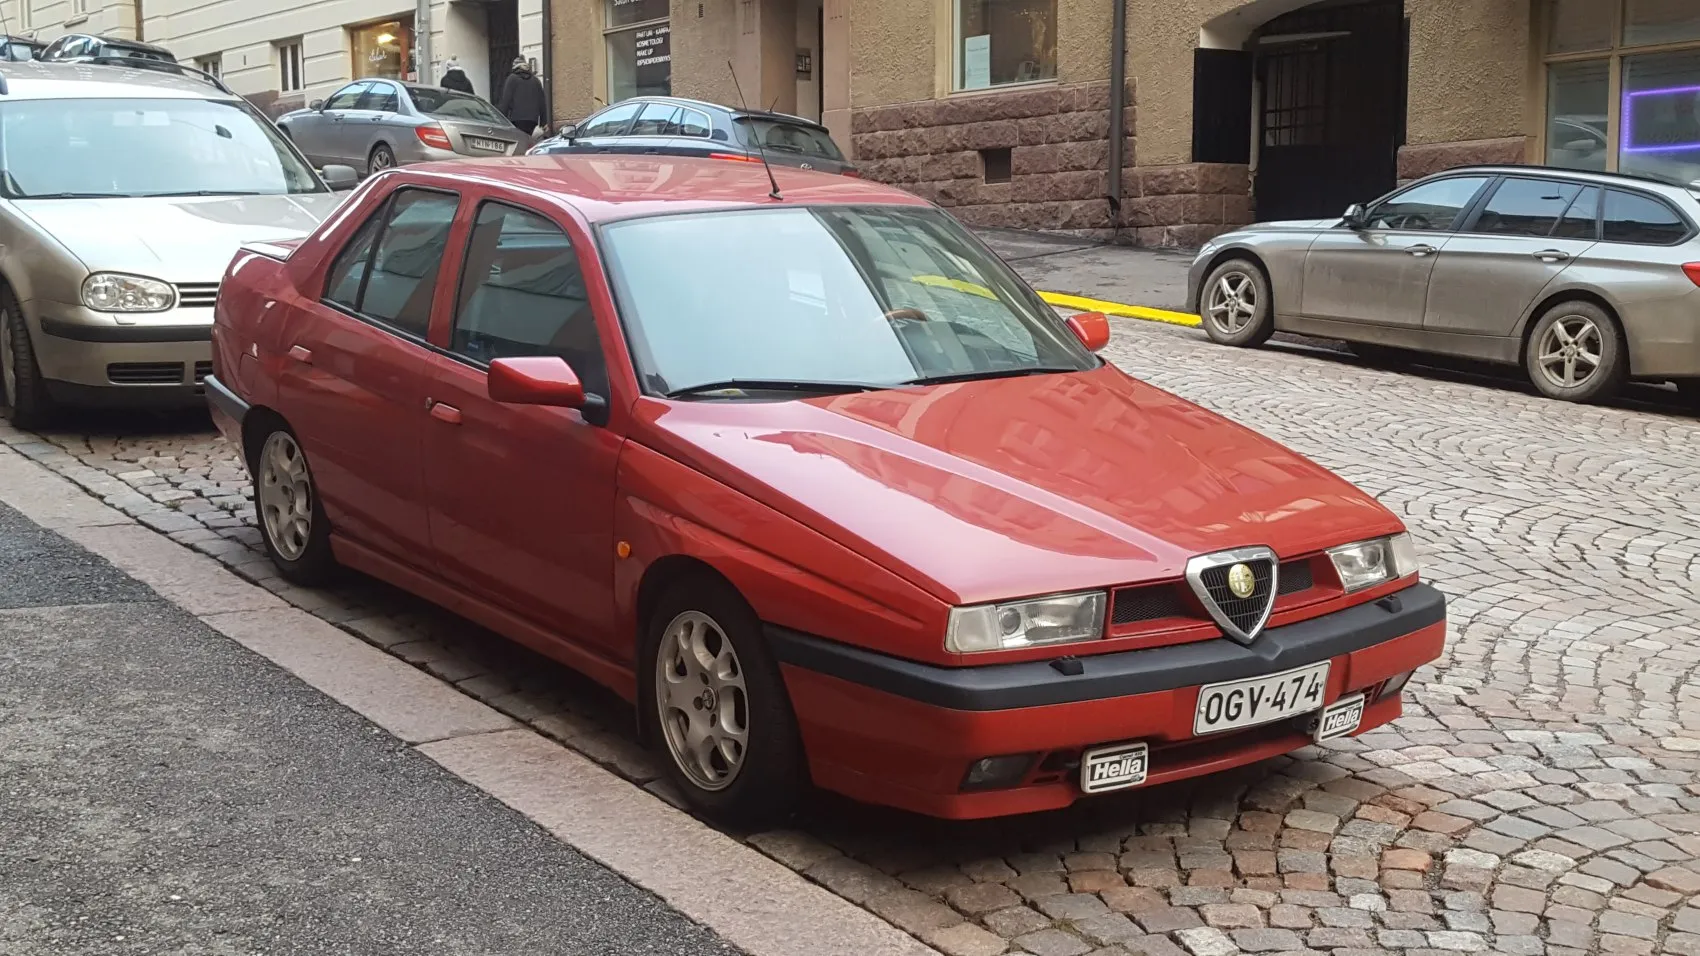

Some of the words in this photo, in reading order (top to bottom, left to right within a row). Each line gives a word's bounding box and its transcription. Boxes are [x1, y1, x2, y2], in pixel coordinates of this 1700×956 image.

[636, 37, 663, 48] KOSMETOLOGI
[648, 48, 654, 56] UP
[1205, 672, 1320, 725] OGV-474
[1325, 709, 1360, 731] Hella
[1094, 758, 1142, 780] Hella
